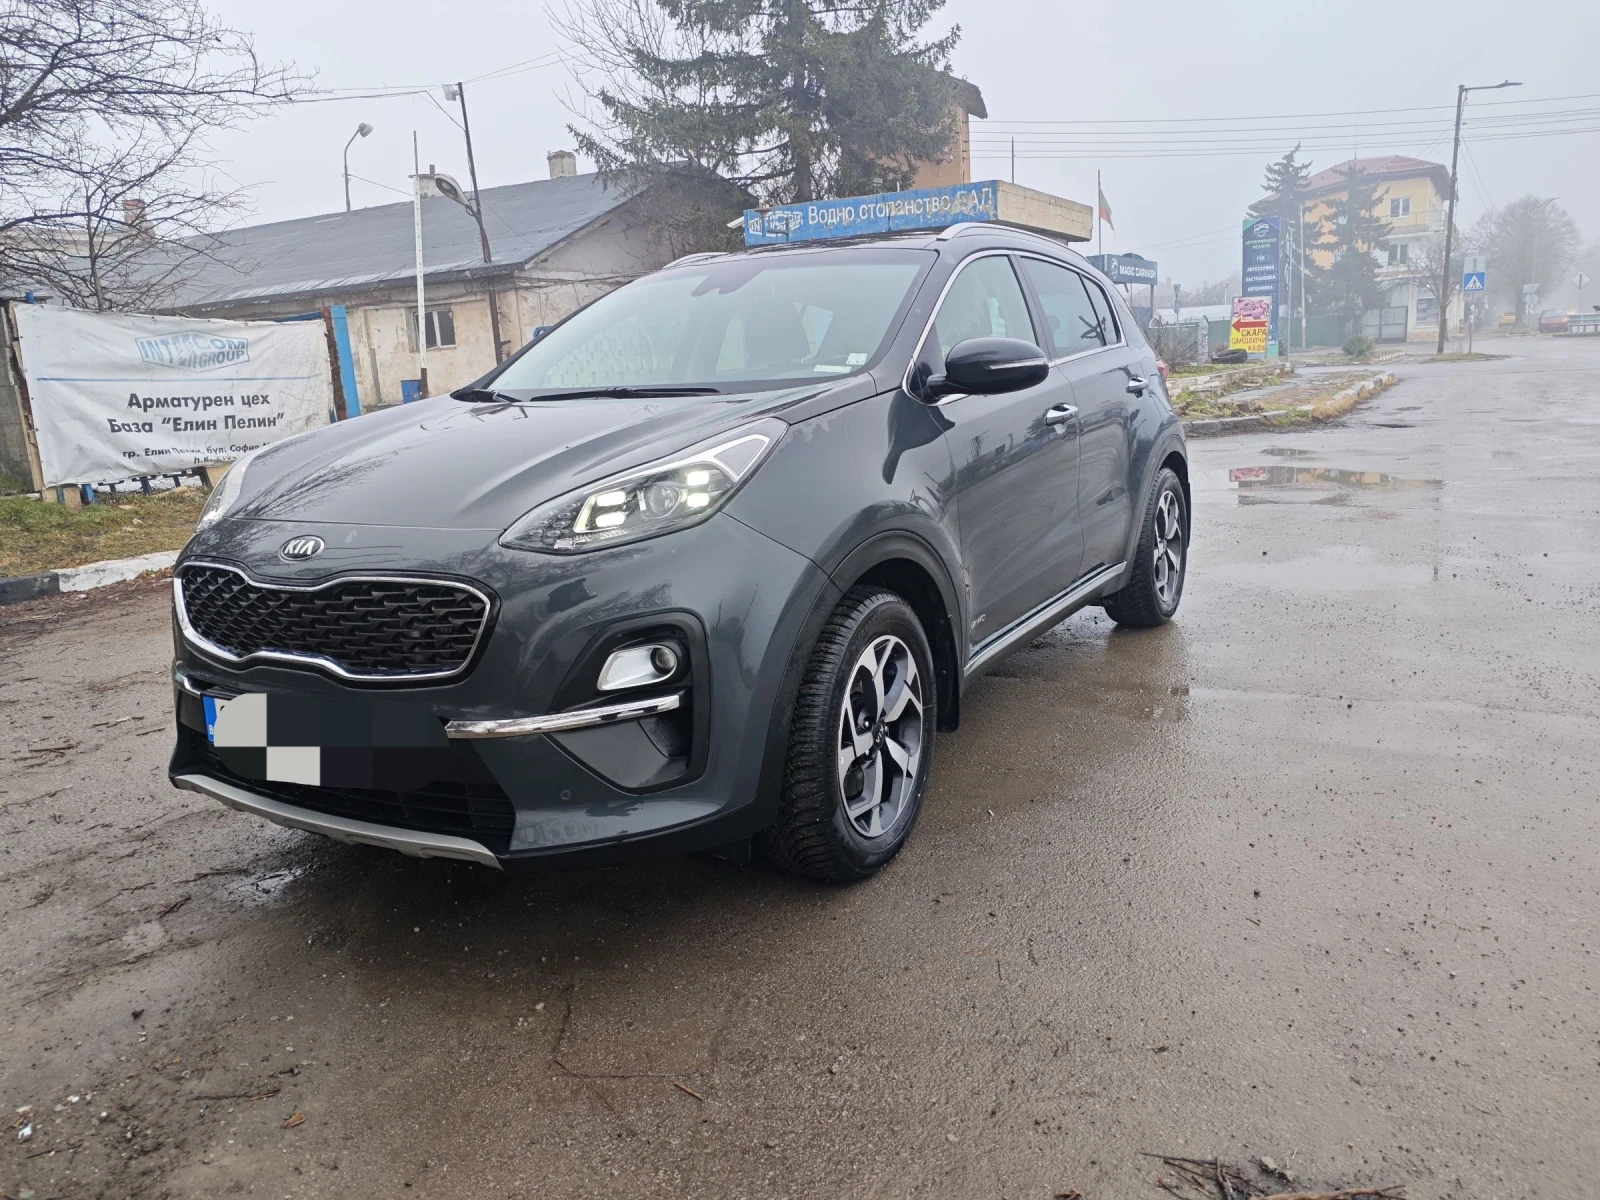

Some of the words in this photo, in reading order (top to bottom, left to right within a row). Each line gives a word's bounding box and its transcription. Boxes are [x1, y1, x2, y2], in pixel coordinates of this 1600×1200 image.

[808, 205, 855, 227] Водно
[859, 195, 950, 220] стопанство
[1119, 265, 1135, 277] MAGIC
[1231, 336, 1267, 345] САНДВИЧИ
[1241, 328, 1267, 337] СКАРА
[198, 350, 246, 368] GROUP
[127, 393, 235, 413] Арматурен
[241, 393, 271, 407] цех
[107, 417, 153, 433] База
[122, 450, 140, 458] гр.
[144, 447, 171, 457] Елин
[283, 539, 316, 555] KIA
